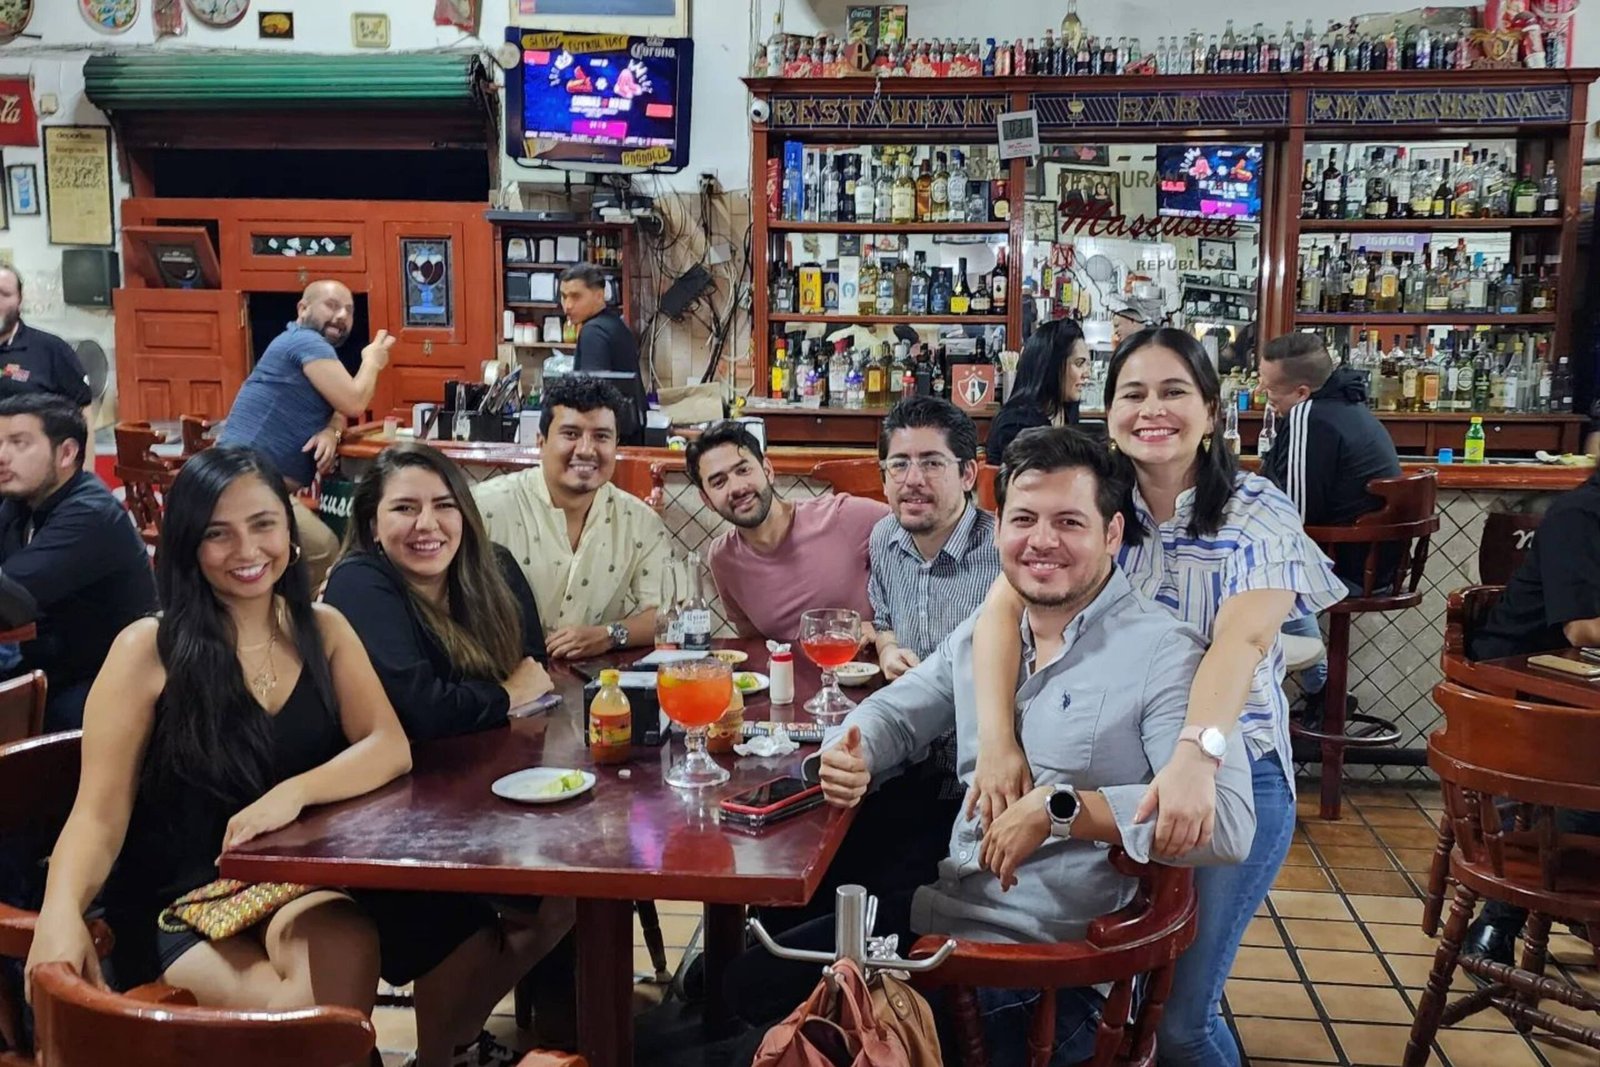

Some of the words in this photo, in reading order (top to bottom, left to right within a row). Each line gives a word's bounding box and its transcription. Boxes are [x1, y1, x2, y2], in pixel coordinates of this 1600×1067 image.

[630, 43, 677, 59] Corona
[774, 98, 1005, 125] RESTAURANT
[1118, 95, 1201, 122] BAR
[1058, 200, 1240, 238] Mascusia
